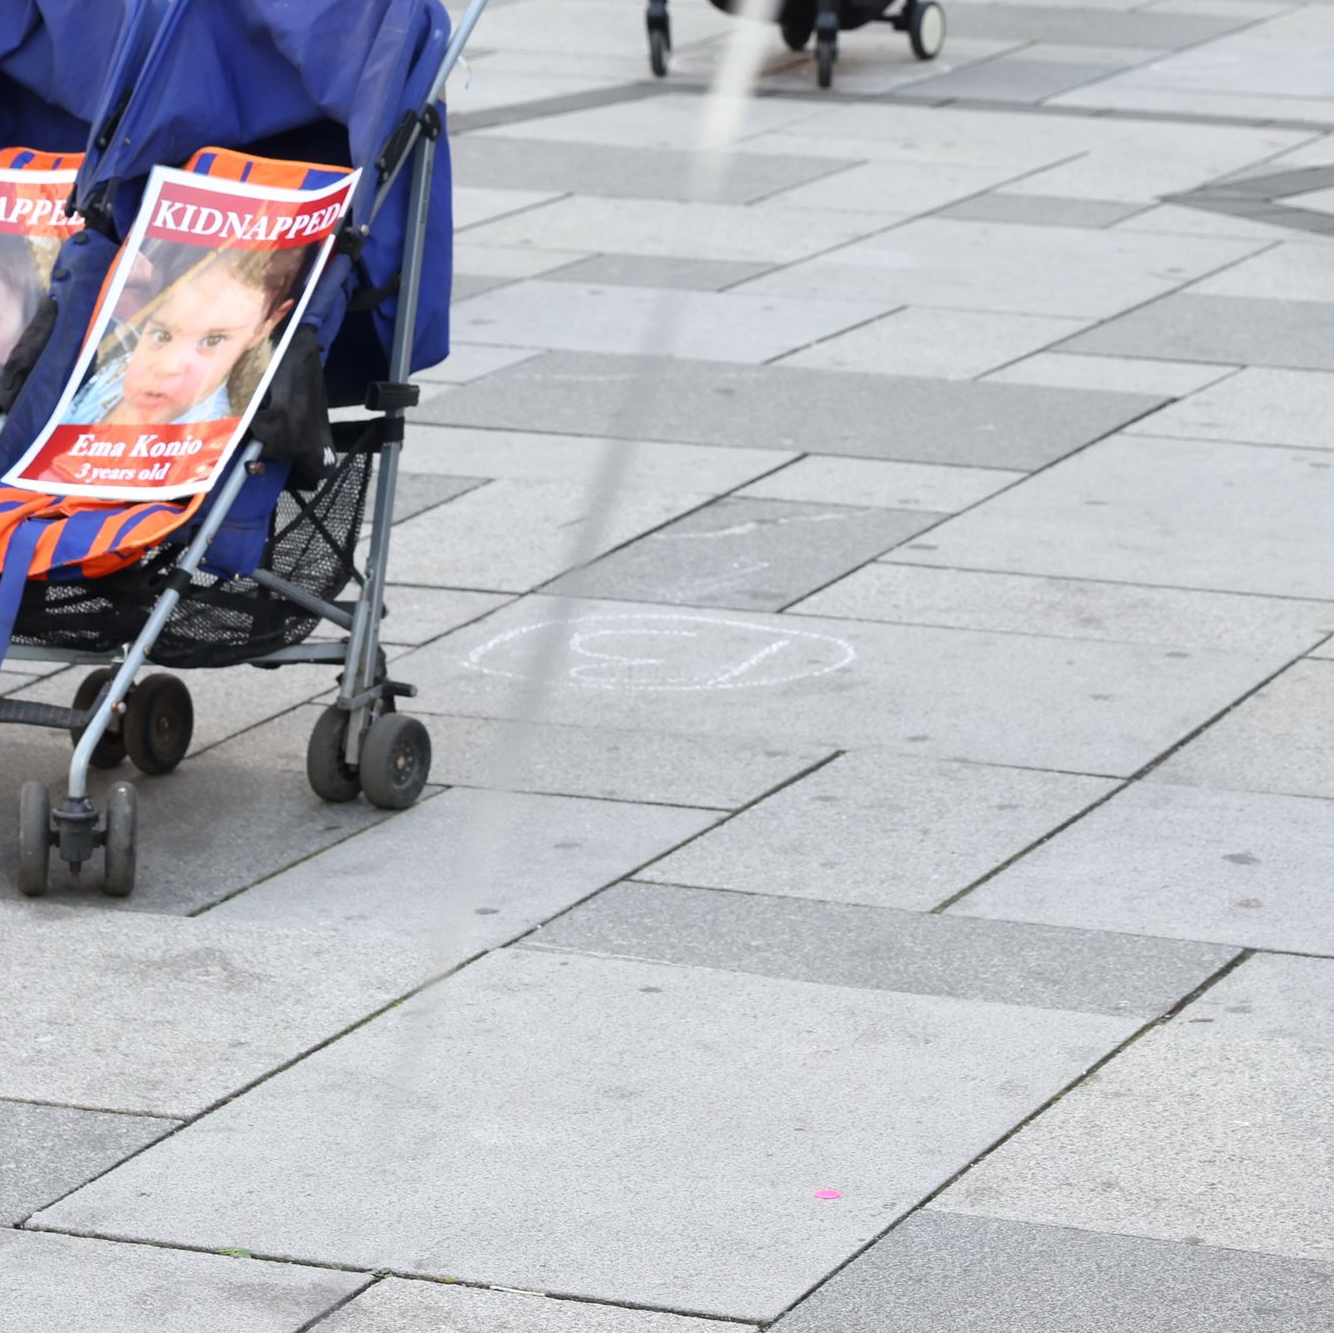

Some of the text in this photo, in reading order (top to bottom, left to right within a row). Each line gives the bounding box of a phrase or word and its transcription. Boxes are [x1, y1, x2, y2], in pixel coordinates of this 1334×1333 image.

[152, 199, 343, 241] KIDNAPPED
[68, 434, 203, 458] Ema Konio
[74, 462, 171, 484] 3 years old
